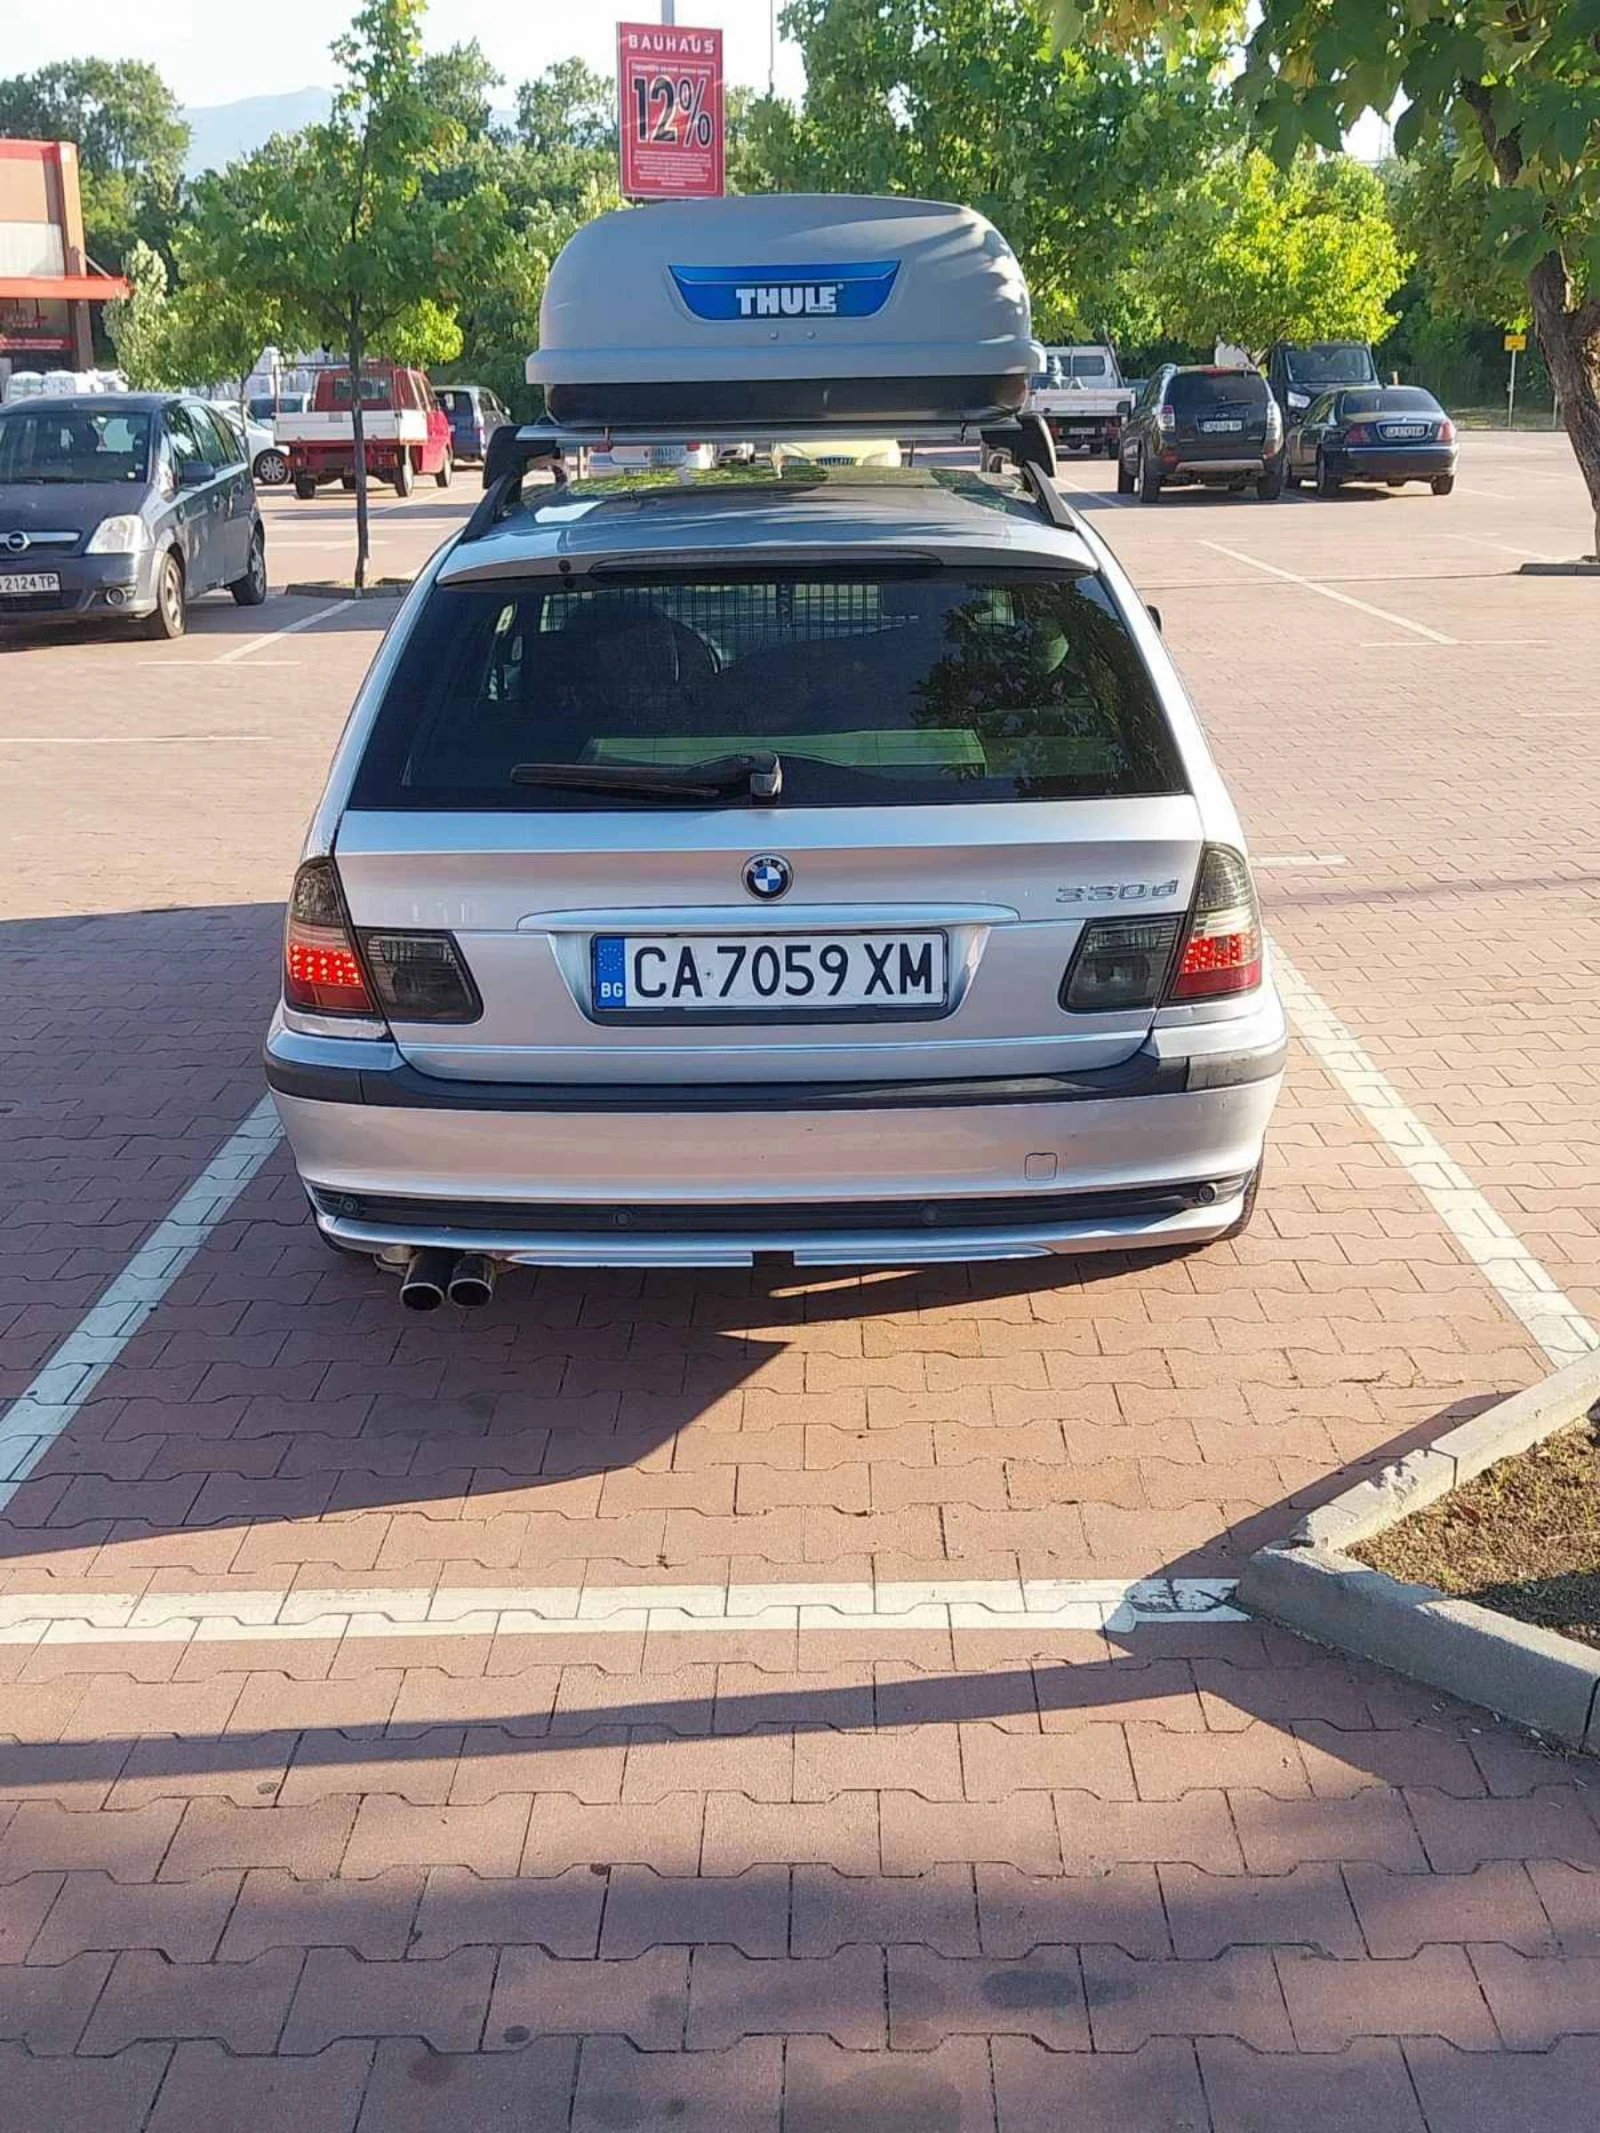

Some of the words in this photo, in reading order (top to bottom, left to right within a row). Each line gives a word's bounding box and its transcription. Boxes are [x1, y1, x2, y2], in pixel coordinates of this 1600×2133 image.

[628, 33, 714, 54] BAUHAUS
[632, 75, 713, 149] 12%
[736, 286, 837, 315] THULE
[4, 576, 37, 590] 2124
[38, 575, 57, 589] TP
[634, 946, 703, 998] CA
[716, 944, 849, 998] 7059
[863, 942, 933, 996] XM
[601, 982, 624, 998] BG
